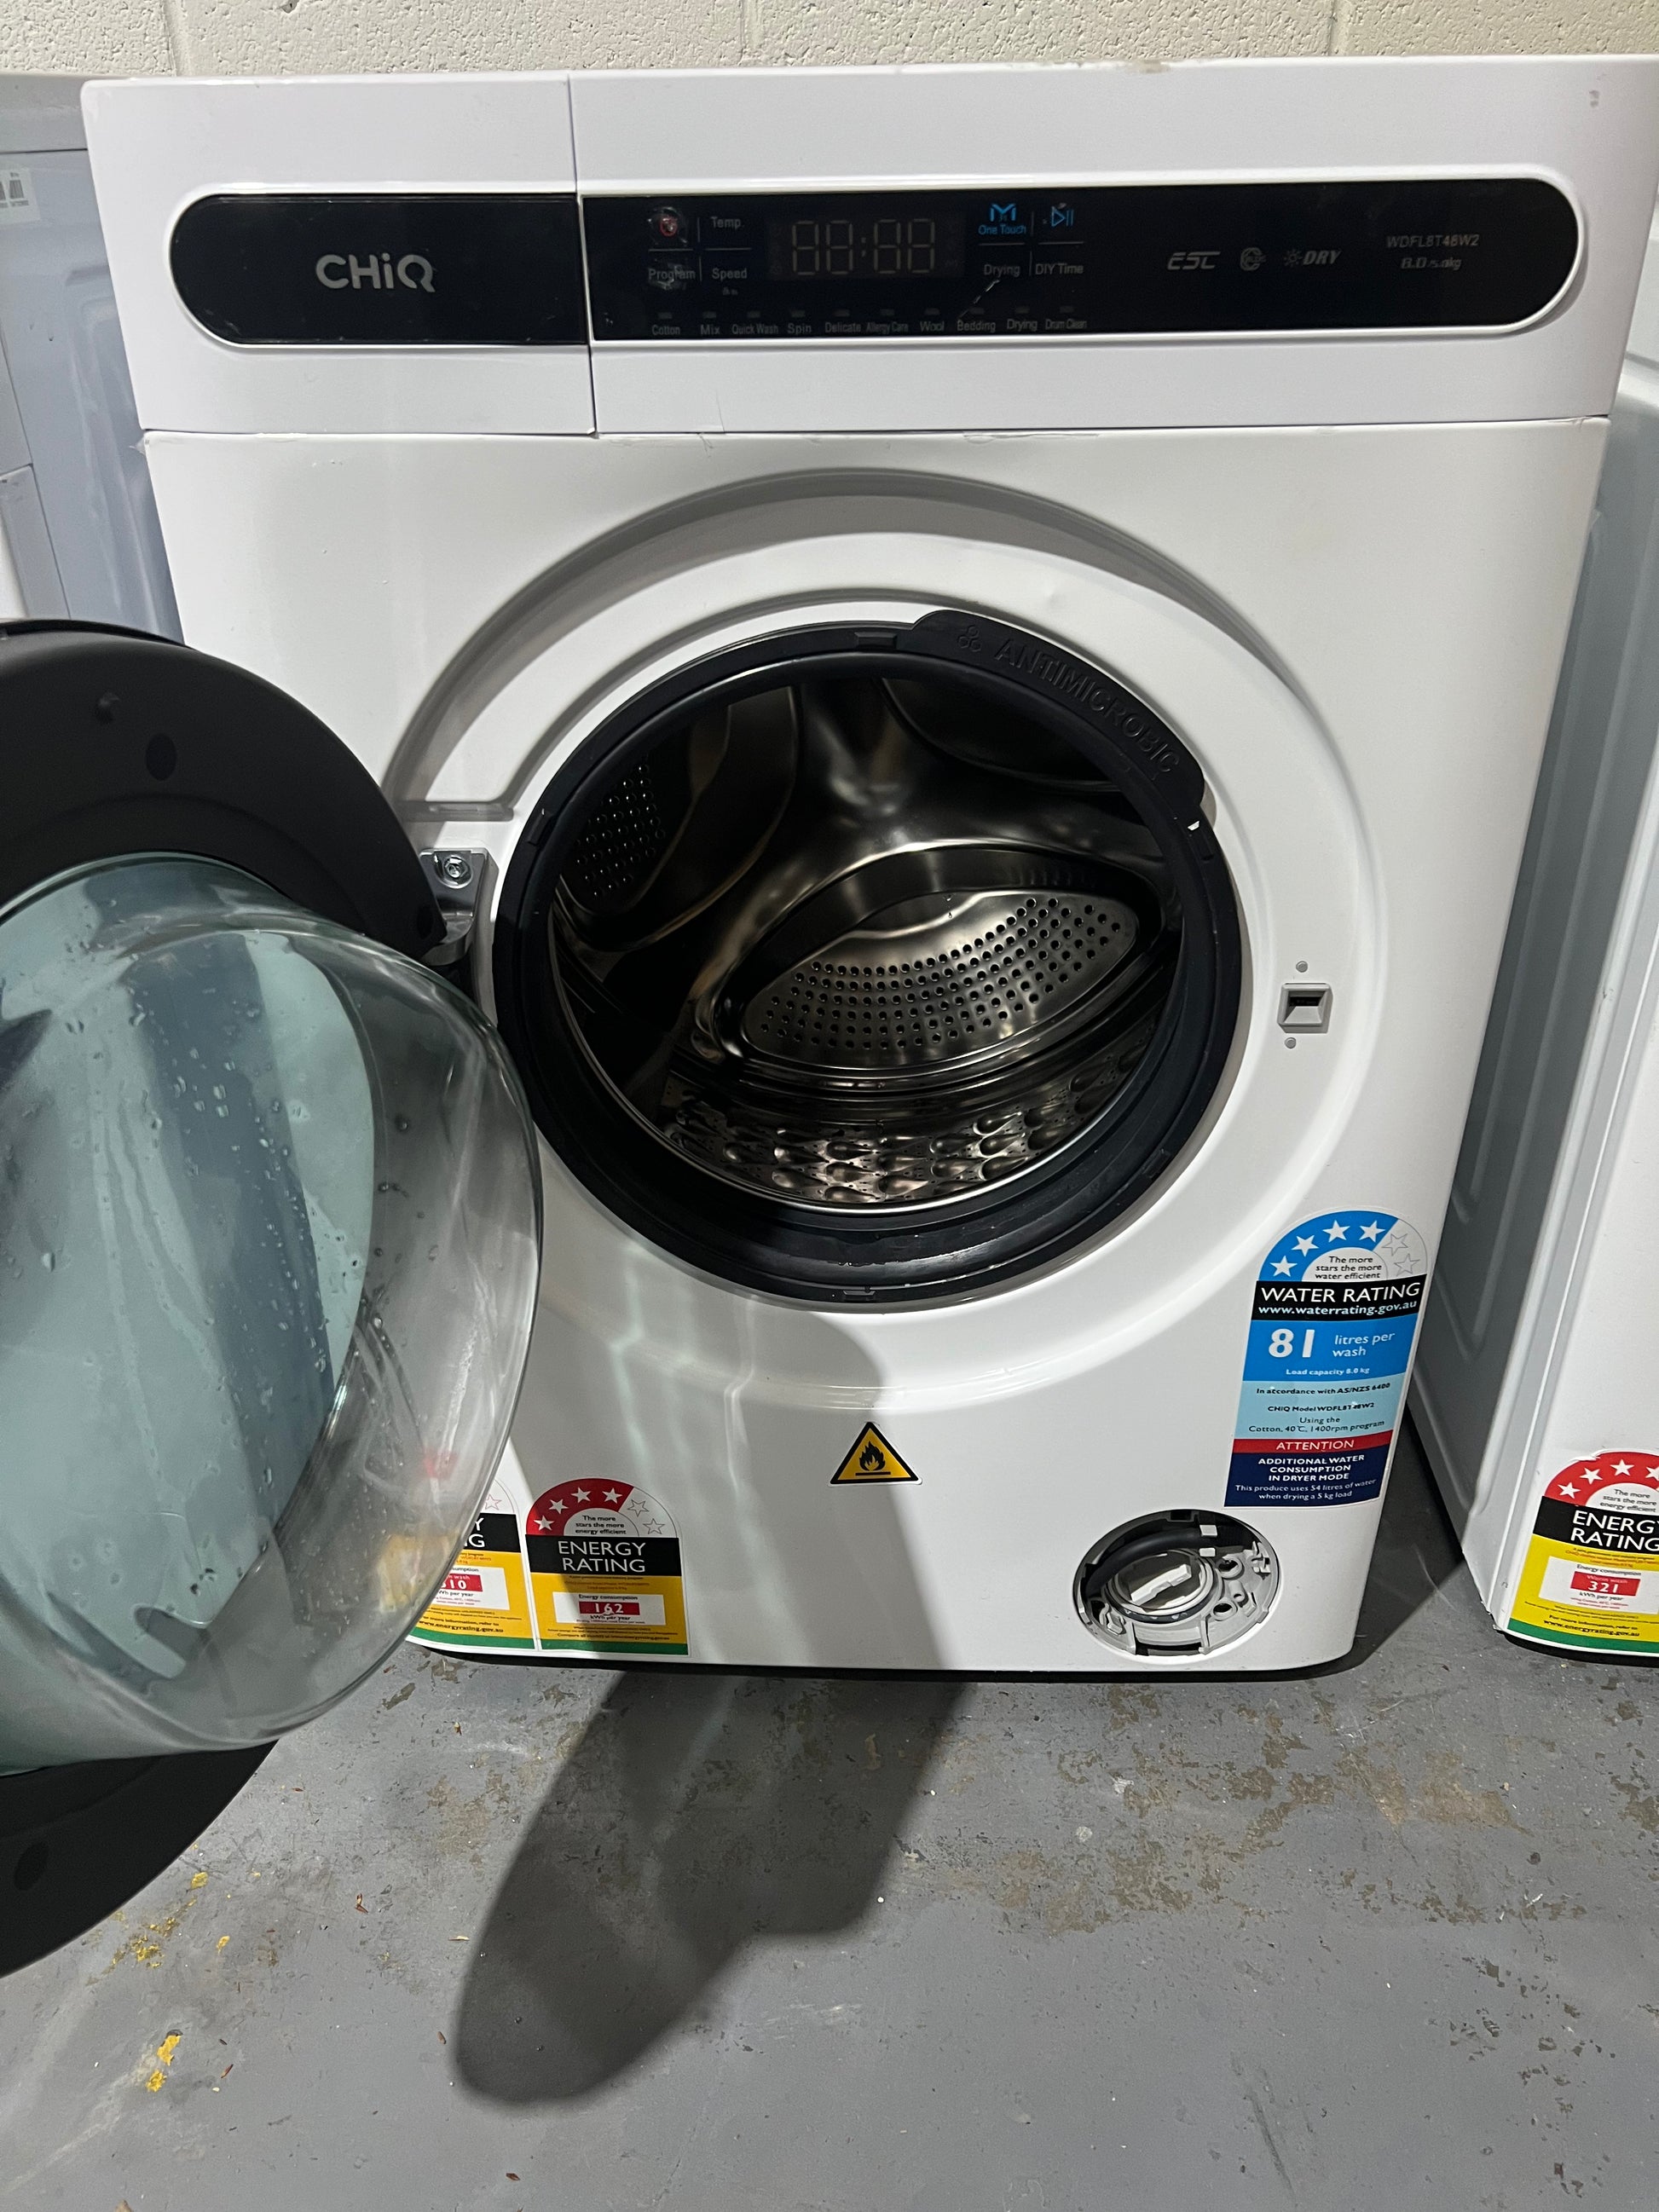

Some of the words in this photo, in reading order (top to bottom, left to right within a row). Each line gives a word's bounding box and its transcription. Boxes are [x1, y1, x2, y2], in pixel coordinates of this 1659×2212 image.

[978, 224, 997, 234] One
[999, 224, 1026, 234] Touch
[1303, 250, 1341, 265] DRY
[315, 252, 435, 292] CHiQ
[983, 263, 1020, 278] Drying
[1035, 263, 1055, 274] DIY
[1057, 263, 1084, 274] Time
[648, 267, 696, 282] Program
[712, 268, 747, 282] Speed
[651, 324, 681, 335] Cotton
[700, 324, 720, 335] Mix
[731, 324, 754, 335] Quick
[756, 324, 779, 335] Wash
[788, 323, 812, 334] Spin
[824, 322, 861, 333] Delicate
[866, 322, 890, 334] Allergy
[892, 321, 909, 332] Care
[920, 321, 945, 332] Wool
[957, 320, 996, 333] Bedding
[1007, 319, 1038, 332] Drying
[1045, 319, 1065, 330] Drum
[994, 639, 1180, 773] ANTIMICROBIC
[1261, 1287, 1336, 1302] WATER
[1343, 1282, 1421, 1302] RATING
[1258, 1301, 1417, 1316] www.waterrating.gov.au
[1269, 1328, 1315, 1358] 81
[1334, 1335, 1368, 1345] litres
[1372, 1332, 1396, 1346] per
[1332, 1346, 1367, 1357] wash
[1337, 1385, 1370, 1394] AS/NZS
[1299, 1417, 1324, 1425] Using
[1350, 1420, 1384, 1431] program
[1276, 1441, 1355, 1451] ATTENTION
[1328, 1454, 1365, 1464] WATER
[1269, 1464, 1351, 1473] CONSUMPTION
[1319, 1473, 1350, 1481] MODE
[1355, 1479, 1377, 1487] water
[1615, 1488, 1628, 1497] The
[1599, 1502, 1625, 1510] energy
[1573, 1510, 1659, 1534] ENERG
[1570, 1528, 1659, 1551] RATING
[558, 1540, 646, 1556] ENERGY
[563, 1557, 645, 1573] RATING
[1577, 1563, 1598, 1573] Energy
[1587, 1580, 1618, 1594] 321
[1543, 1620, 1640, 1637] www.energyrating.gov.au
[1578, 1620, 1615, 1628] information,
